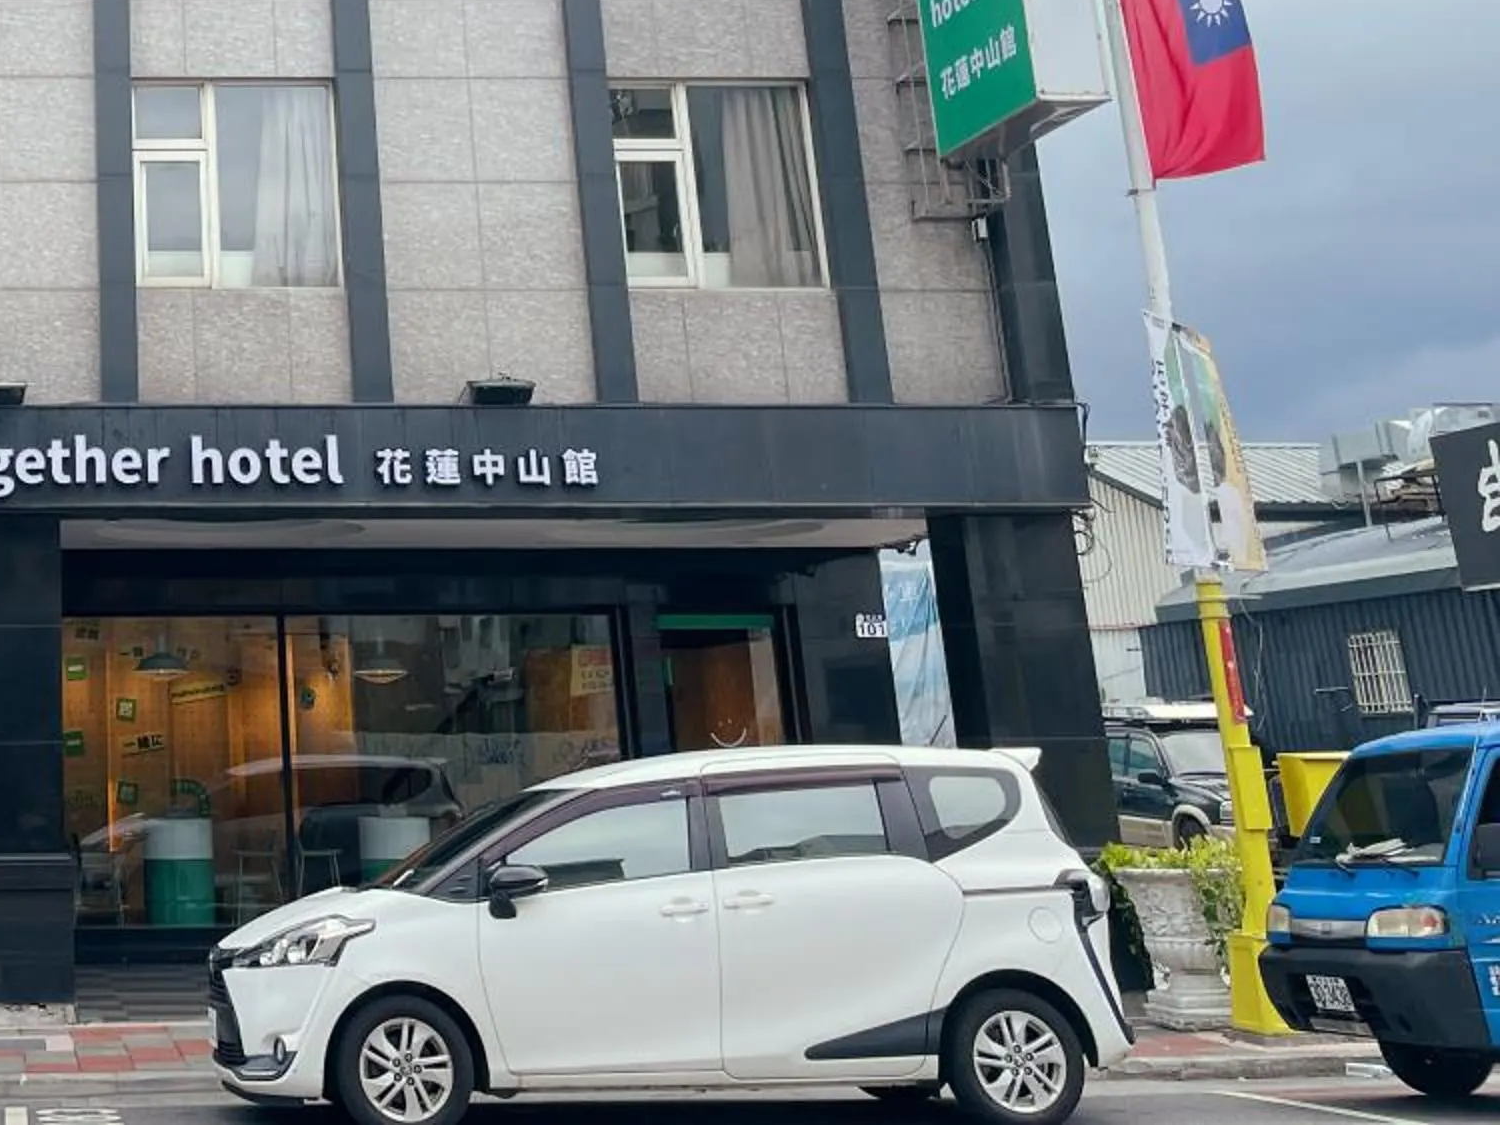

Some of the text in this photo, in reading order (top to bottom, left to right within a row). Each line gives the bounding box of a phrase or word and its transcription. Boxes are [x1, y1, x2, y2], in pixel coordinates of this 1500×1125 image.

[940, 23, 1017, 99] 花蓮中山館
[191, 434, 344, 485] hotel
[376, 448, 599, 485] 花蓮中山館
[859, 622, 886, 636] 101
